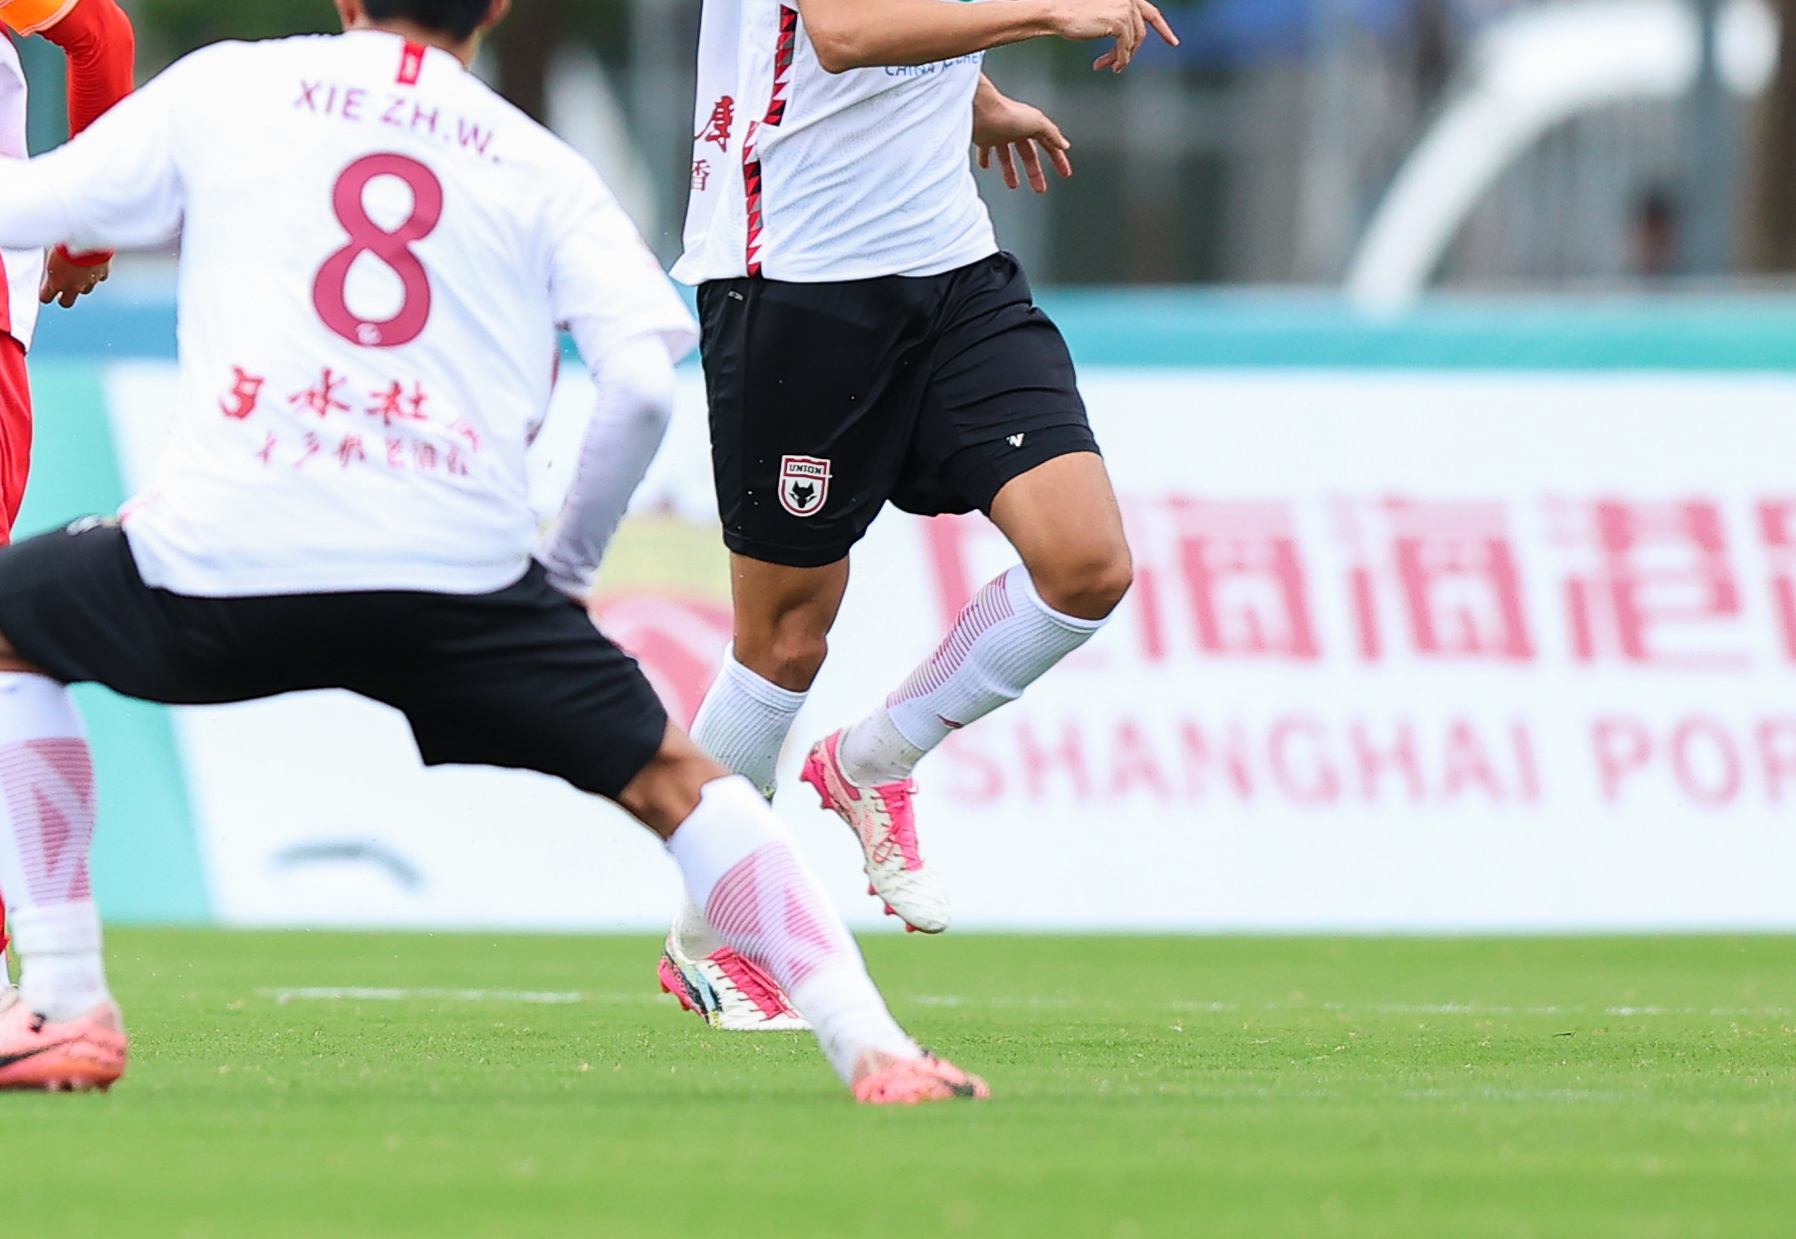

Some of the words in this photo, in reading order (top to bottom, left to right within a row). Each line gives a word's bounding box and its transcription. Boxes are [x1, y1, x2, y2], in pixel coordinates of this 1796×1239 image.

[293, 79, 367, 122] XIE
[380, 93, 500, 163] ZH.W.
[312, 152, 443, 347] 8
[789, 464, 822, 475] UNION
[949, 715, 1540, 807] SHANGHAI
